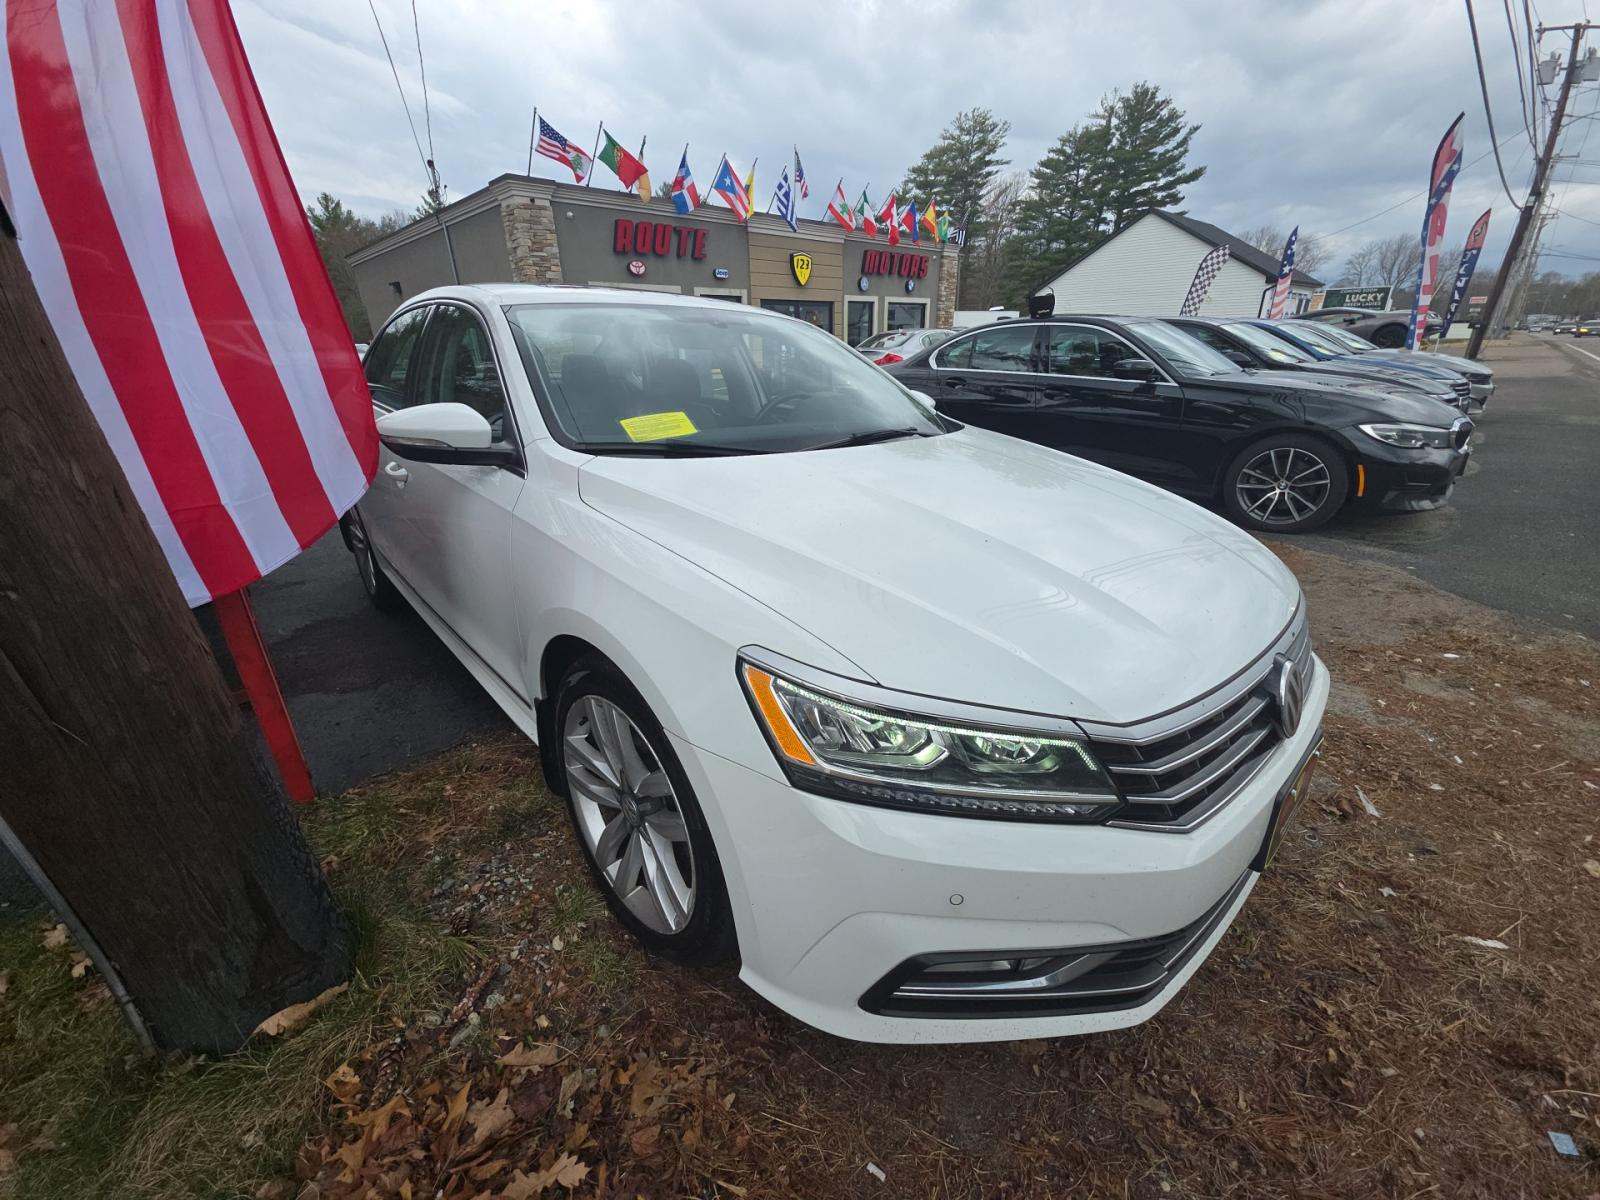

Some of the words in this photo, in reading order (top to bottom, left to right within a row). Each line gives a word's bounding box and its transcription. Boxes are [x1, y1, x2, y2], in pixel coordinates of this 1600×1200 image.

[614, 218, 709, 259] ROUTE
[796, 257, 810, 270] 123
[862, 250, 928, 278] MOTORS
[1345, 293, 1384, 303] LUCKY
